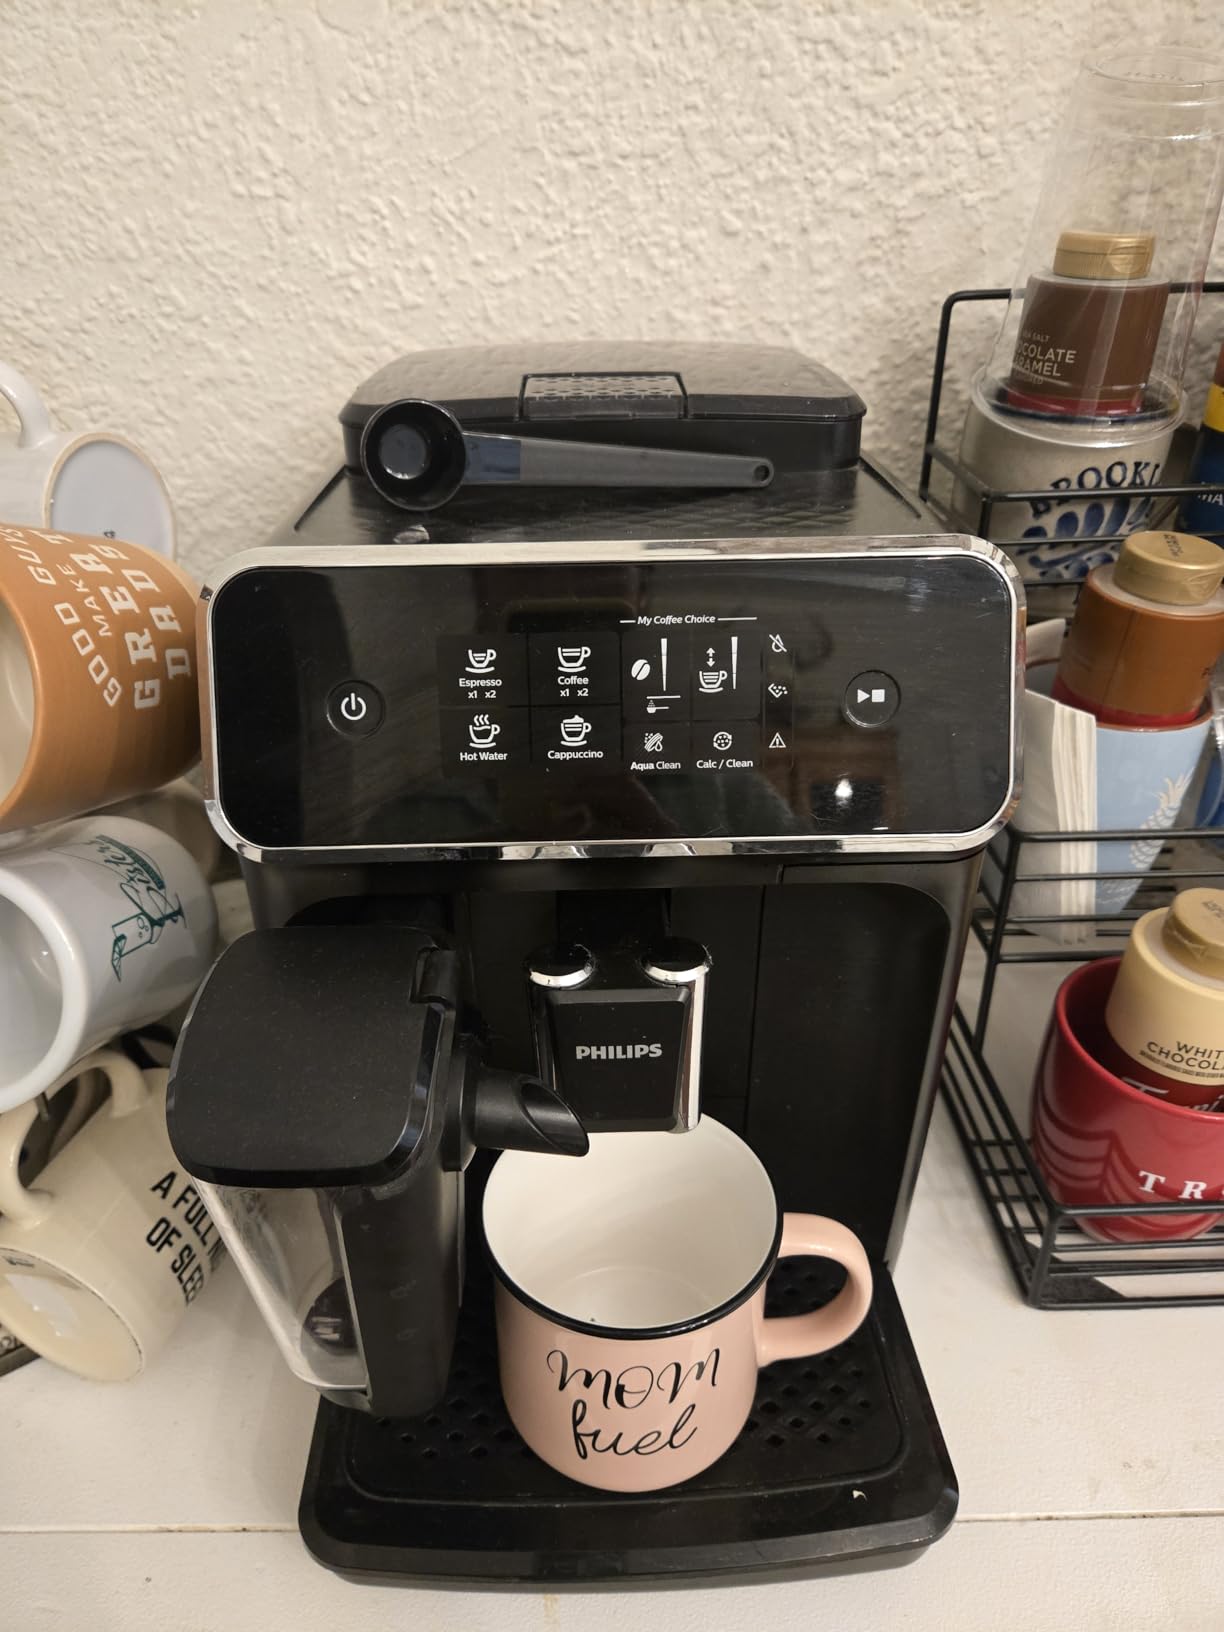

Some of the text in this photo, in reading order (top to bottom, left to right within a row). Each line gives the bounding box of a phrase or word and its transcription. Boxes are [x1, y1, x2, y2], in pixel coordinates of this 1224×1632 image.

[56, 563, 112, 637] MAKE
[27, 529, 161, 711] GREAT
[88, 544, 192, 681] DADS
[637, 614, 716, 626] My Coffee Choice
[54, 602, 122, 707] GOOD
[458, 677, 503, 689] Espresso
[557, 675, 590, 686] Coffee
[467, 689, 497, 699] x1 x2
[559, 688, 589, 697] x1 x2
[459, 751, 508, 761] Hot Water
[547, 749, 604, 761] Cappuccino
[696, 759, 717, 769] Calc
[725, 758, 754, 768] Clean
[630, 760, 681, 771] Aqua Clean
[575, 1043, 663, 1060] PHILIPS
[1146, 1041, 1224, 1071] CHOCOL
[1176, 1041, 1224, 1061] WHIT
[1138, 1170, 1224, 1200] TR
[150, 1170, 215, 1248] A FULL
[145, 1216, 183, 1254] OF
[571, 1398, 698, 1460] fuel
